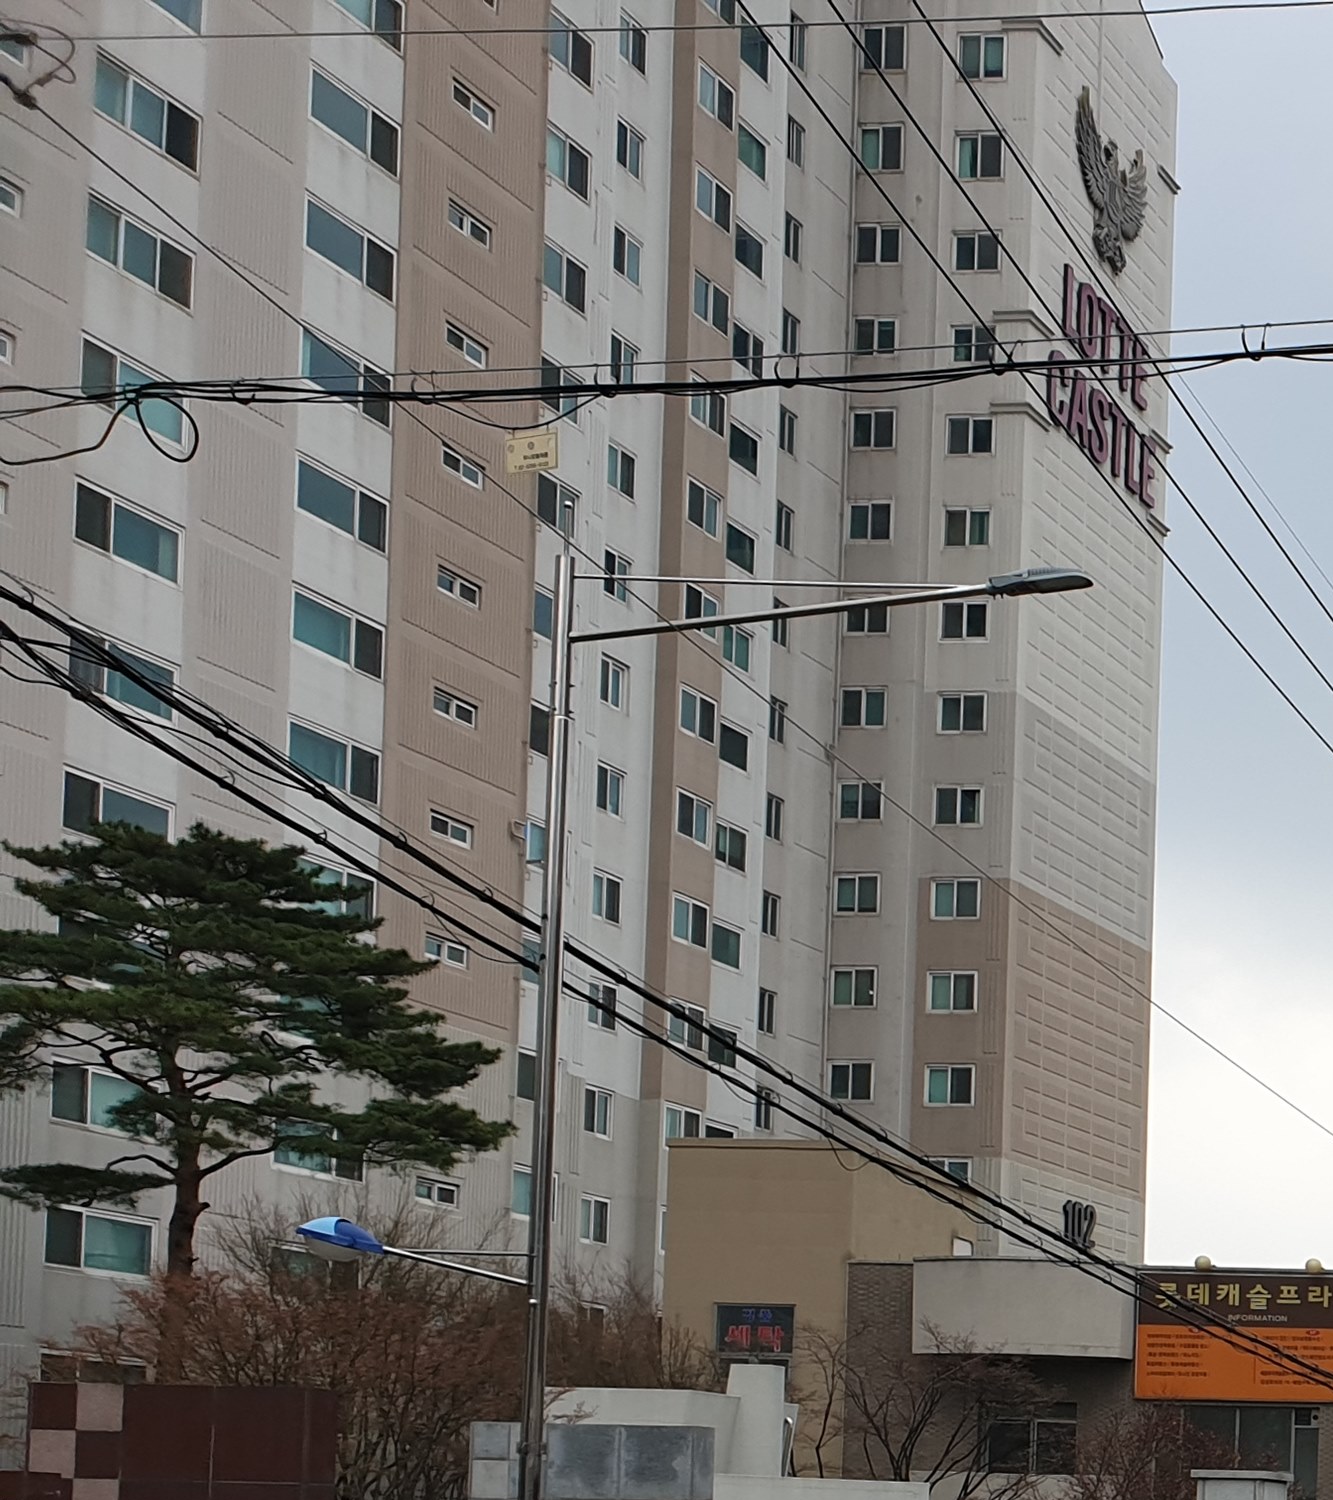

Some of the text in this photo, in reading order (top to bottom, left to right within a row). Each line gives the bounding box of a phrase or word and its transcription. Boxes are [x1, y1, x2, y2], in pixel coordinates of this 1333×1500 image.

[1062, 263, 1149, 411] LOTTE
[1046, 349, 1156, 508] CASTLE
[1062, 1199, 1096, 1249] 102
[1227, 1314, 1288, 1323] INFORMATION
